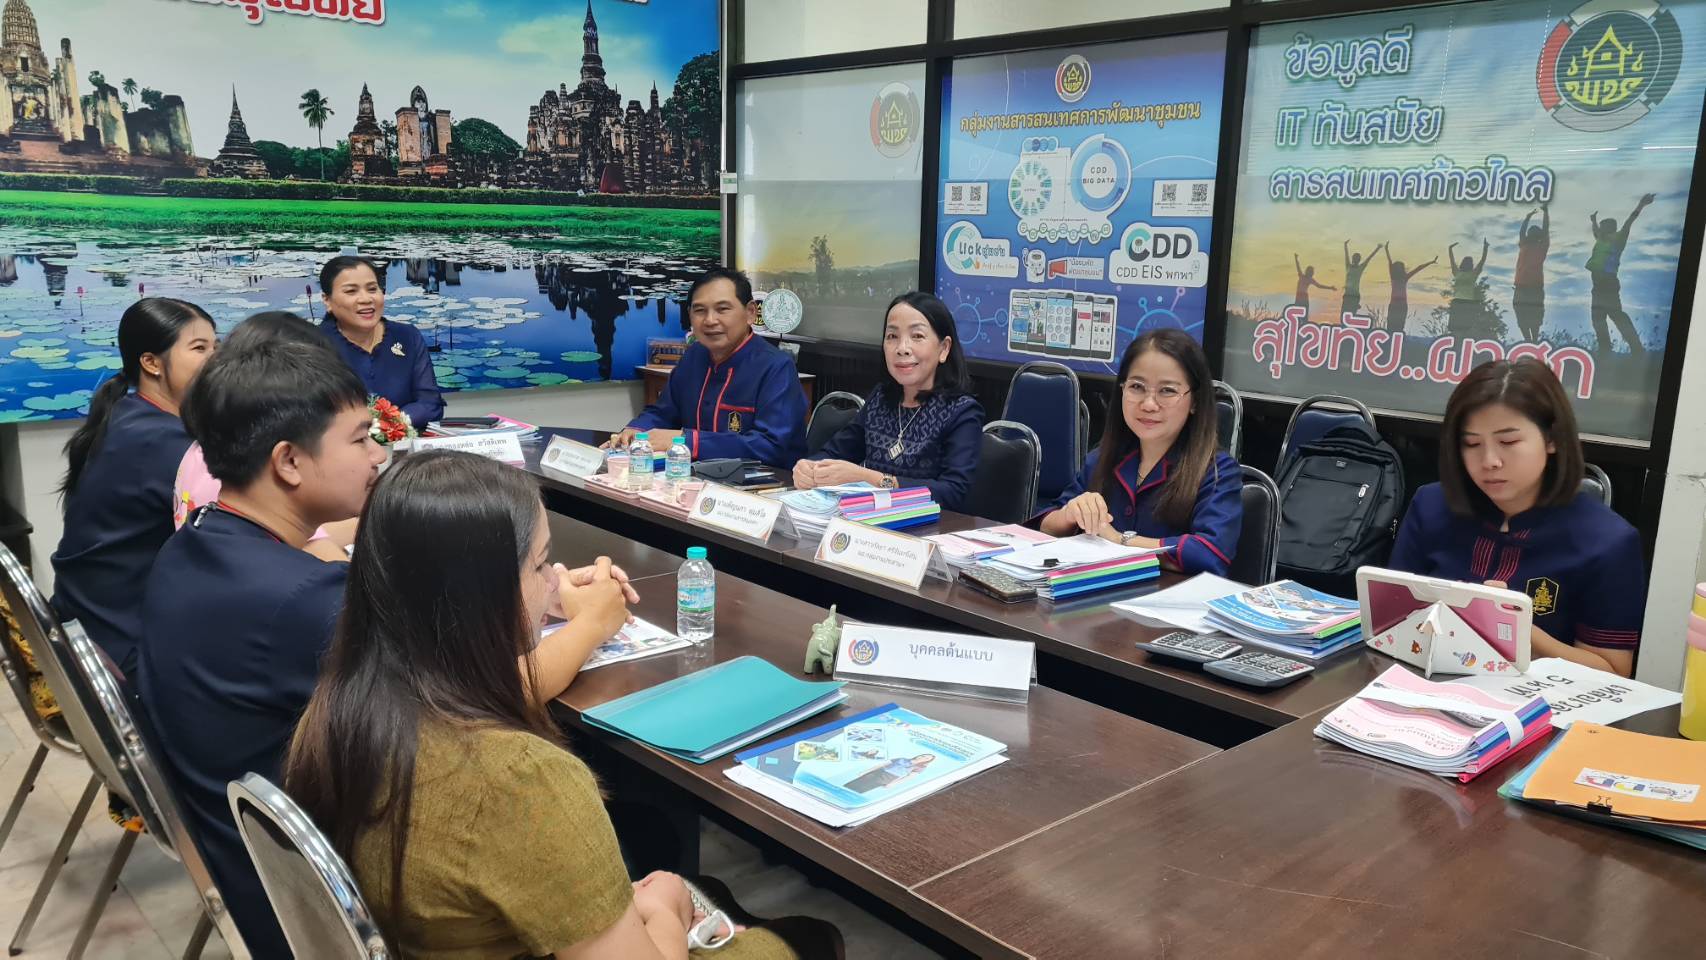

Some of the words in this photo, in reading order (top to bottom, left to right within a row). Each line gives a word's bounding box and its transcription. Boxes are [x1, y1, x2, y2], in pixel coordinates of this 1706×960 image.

[1285, 26, 1414, 88] ข้อมูลดี
[959, 101, 1201, 137] กลุ่มงานสารสนเทศการพัฒนาชุมชน
[1276, 107, 1306, 146] IT
[1313, 97, 1443, 146] ทันสมัย
[1090, 166, 1107, 174] CDD
[1270, 156, 1552, 202] สารสนเทศก้าวไกล
[1125, 228, 1193, 262] CDD
[1116, 267, 1138, 278] CDD
[1142, 264, 1163, 279] EIS
[909, 642, 993, 662] บุคคลต้นแบบ
[1547, 675, 1574, 685] 5
